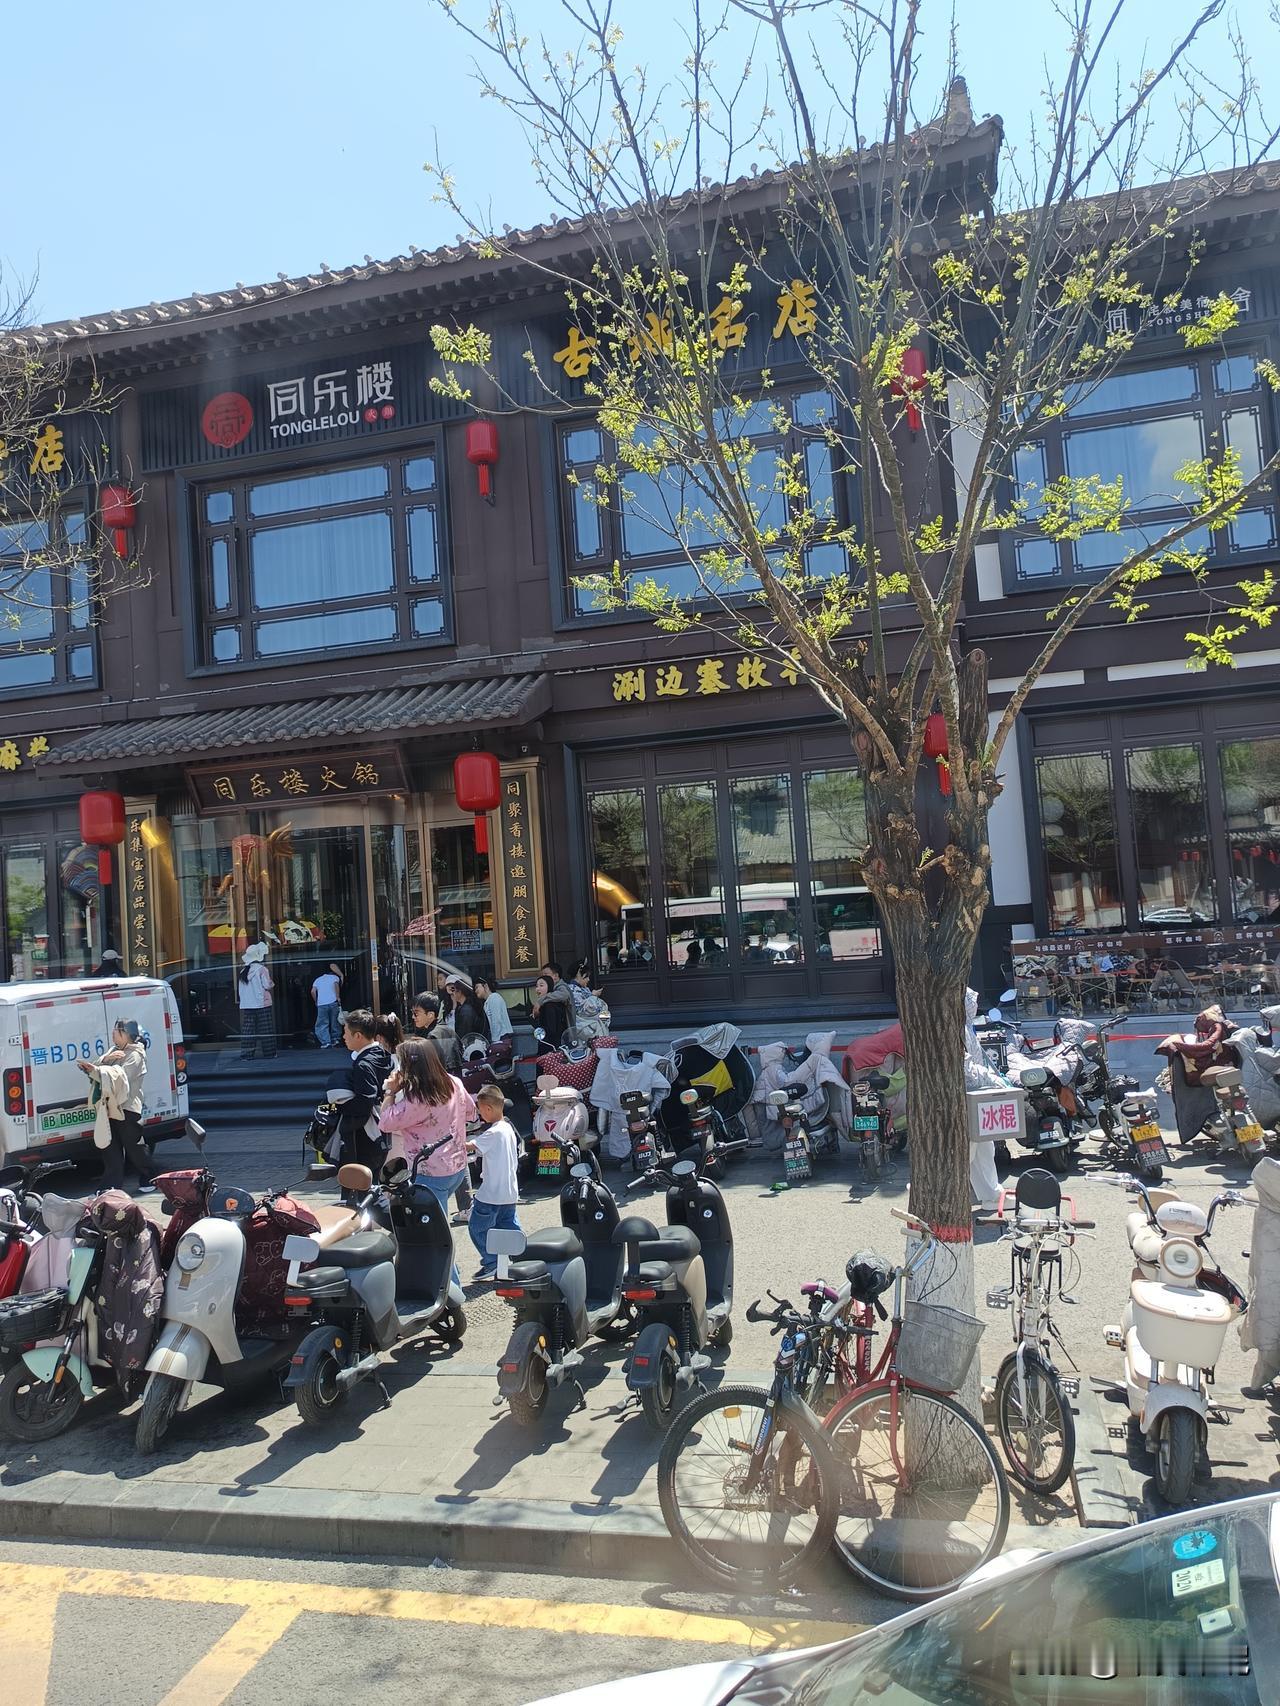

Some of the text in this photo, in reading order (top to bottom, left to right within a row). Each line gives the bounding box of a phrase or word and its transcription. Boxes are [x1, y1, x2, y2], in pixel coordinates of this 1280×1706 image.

[267, 361, 394, 423] 同乐楼
[270, 410, 360, 439] TONGLELOU
[213, 761, 379, 801] 同乐楼火锅
[130, 818, 150, 978] 乐集宝店品尝火锅
[981, 1103, 1017, 1130] 冰棍
